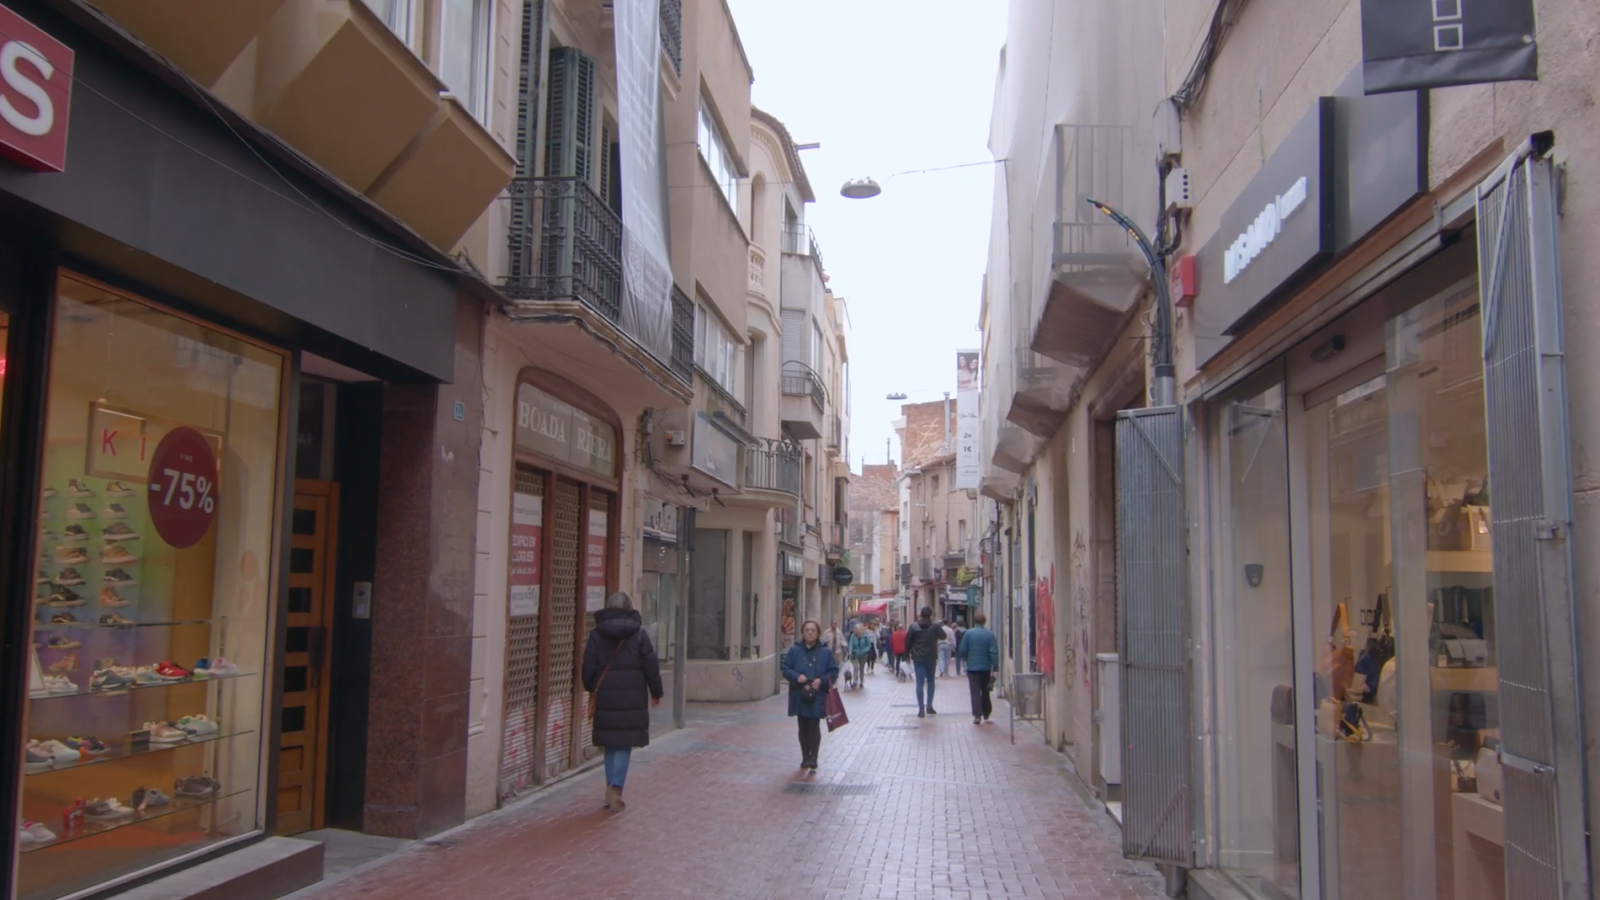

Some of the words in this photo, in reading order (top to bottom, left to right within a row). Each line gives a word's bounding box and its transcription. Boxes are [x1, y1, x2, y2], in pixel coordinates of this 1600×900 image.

[0, 40, 54, 136] S
[518, 401, 567, 443] BOADA
[577, 427, 612, 462] RIERA
[151, 468, 214, 514] -75%
